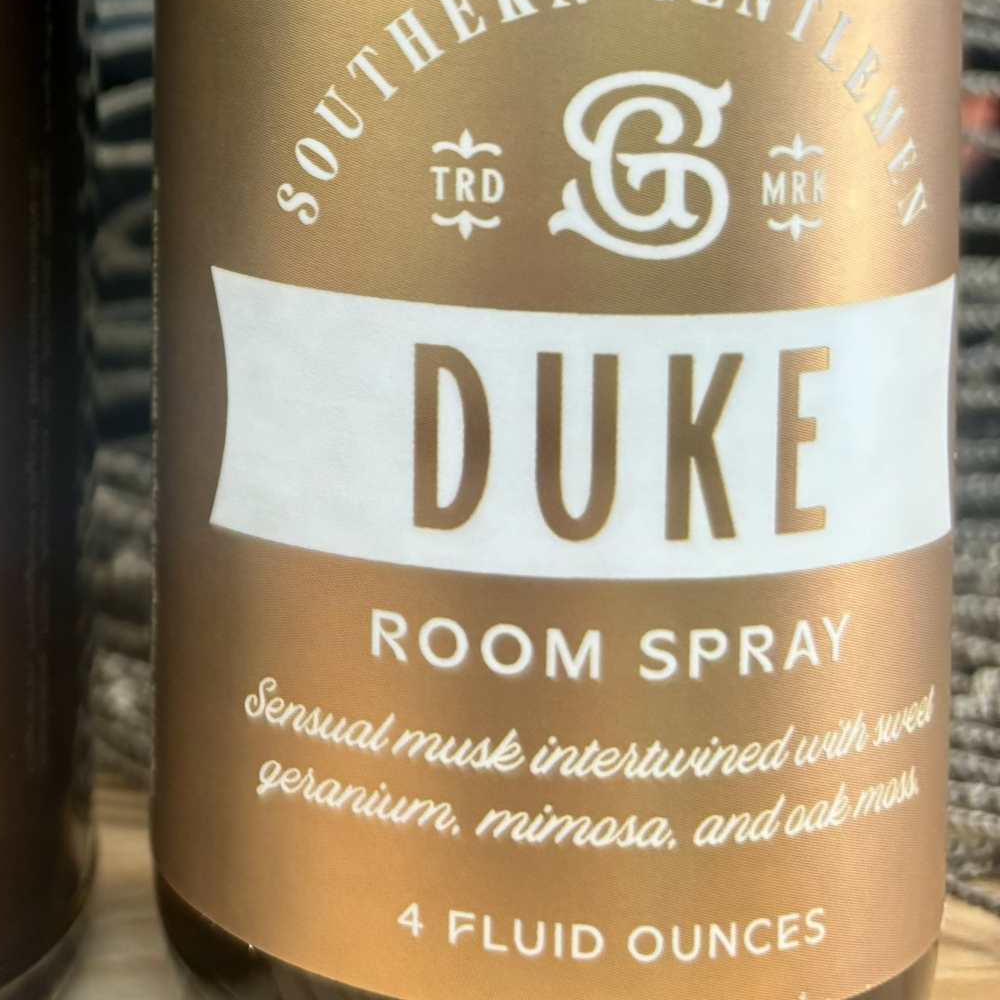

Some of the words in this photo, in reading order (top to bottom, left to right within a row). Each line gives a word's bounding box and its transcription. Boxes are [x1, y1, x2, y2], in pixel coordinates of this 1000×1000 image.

[429, 165, 505, 205] TRD
[761, 169, 826, 206] MRK
[412, 342, 831, 542] DUKE
[370, 607, 602, 681] ROOM
[638, 613, 851, 681] SPRAY
[245, 676, 396, 752] Sensual
[391, 728, 525, 772] musk
[529, 725, 795, 779] intertwined
[794, 710, 872, 767] with
[872, 684, 935, 747] sweet
[692, 793, 785, 847] and
[783, 781, 849, 836] oak
[397, 901, 424, 938] 4
[447, 909, 605, 961] FLUID
[626, 907, 826, 964] OUNCES
